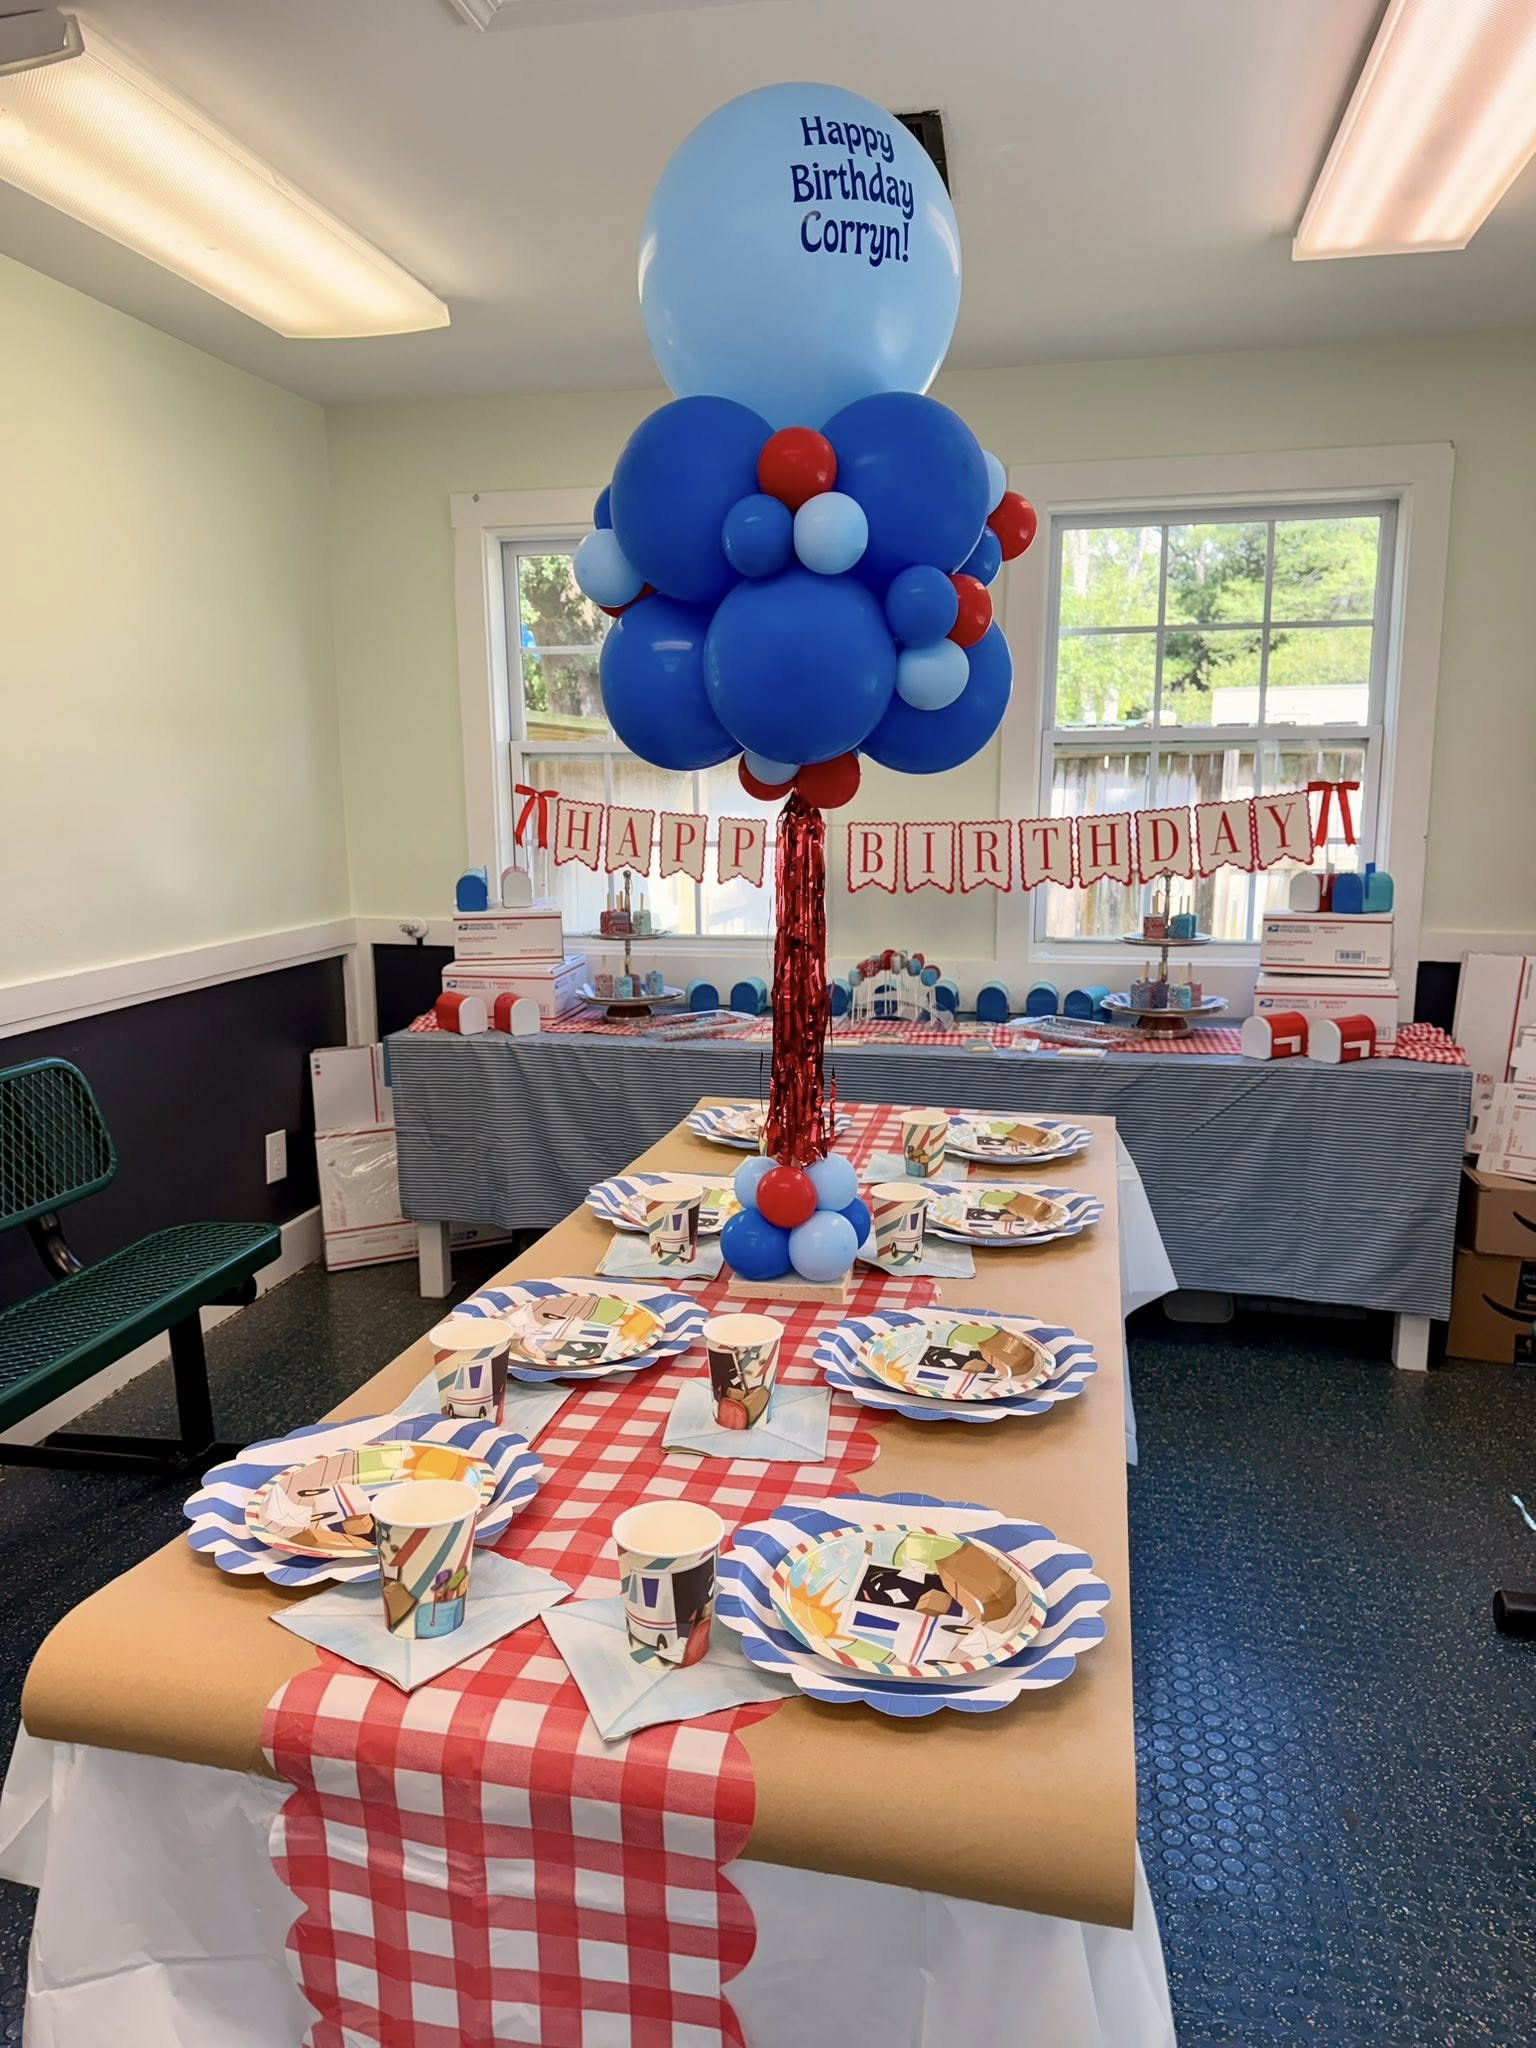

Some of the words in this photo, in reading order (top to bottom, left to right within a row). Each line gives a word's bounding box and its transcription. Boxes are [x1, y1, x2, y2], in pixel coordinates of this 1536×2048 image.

[800, 115, 895, 164] Happy
[790, 158, 914, 220] Birthday
[800, 210, 910, 267] Corryn!
[564, 808, 755, 867] HAPP
[859, 801, 1296, 875] BIRTHDAY
